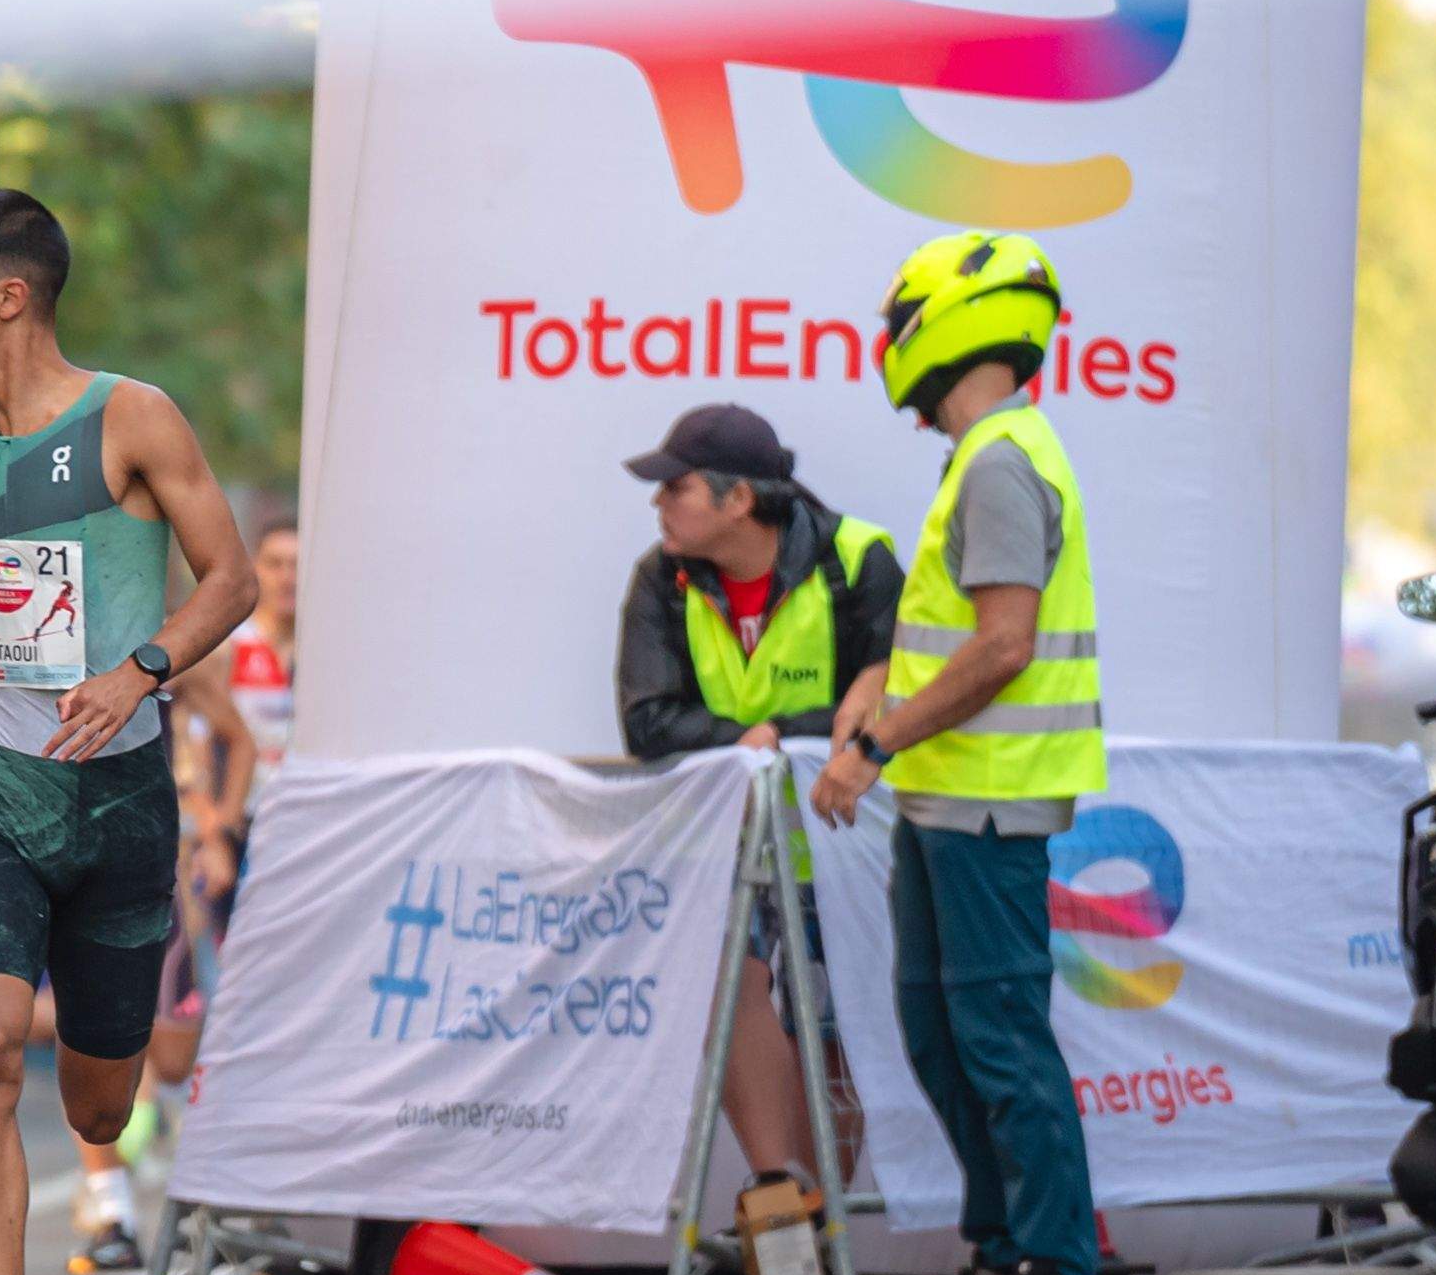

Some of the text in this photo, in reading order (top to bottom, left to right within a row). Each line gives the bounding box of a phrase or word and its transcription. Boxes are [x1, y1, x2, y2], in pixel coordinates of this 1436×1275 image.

[480, 298, 1178, 406] TotalEnies
[37, 546, 68, 575] 21
[1072, 1052, 1233, 1125] nergies
